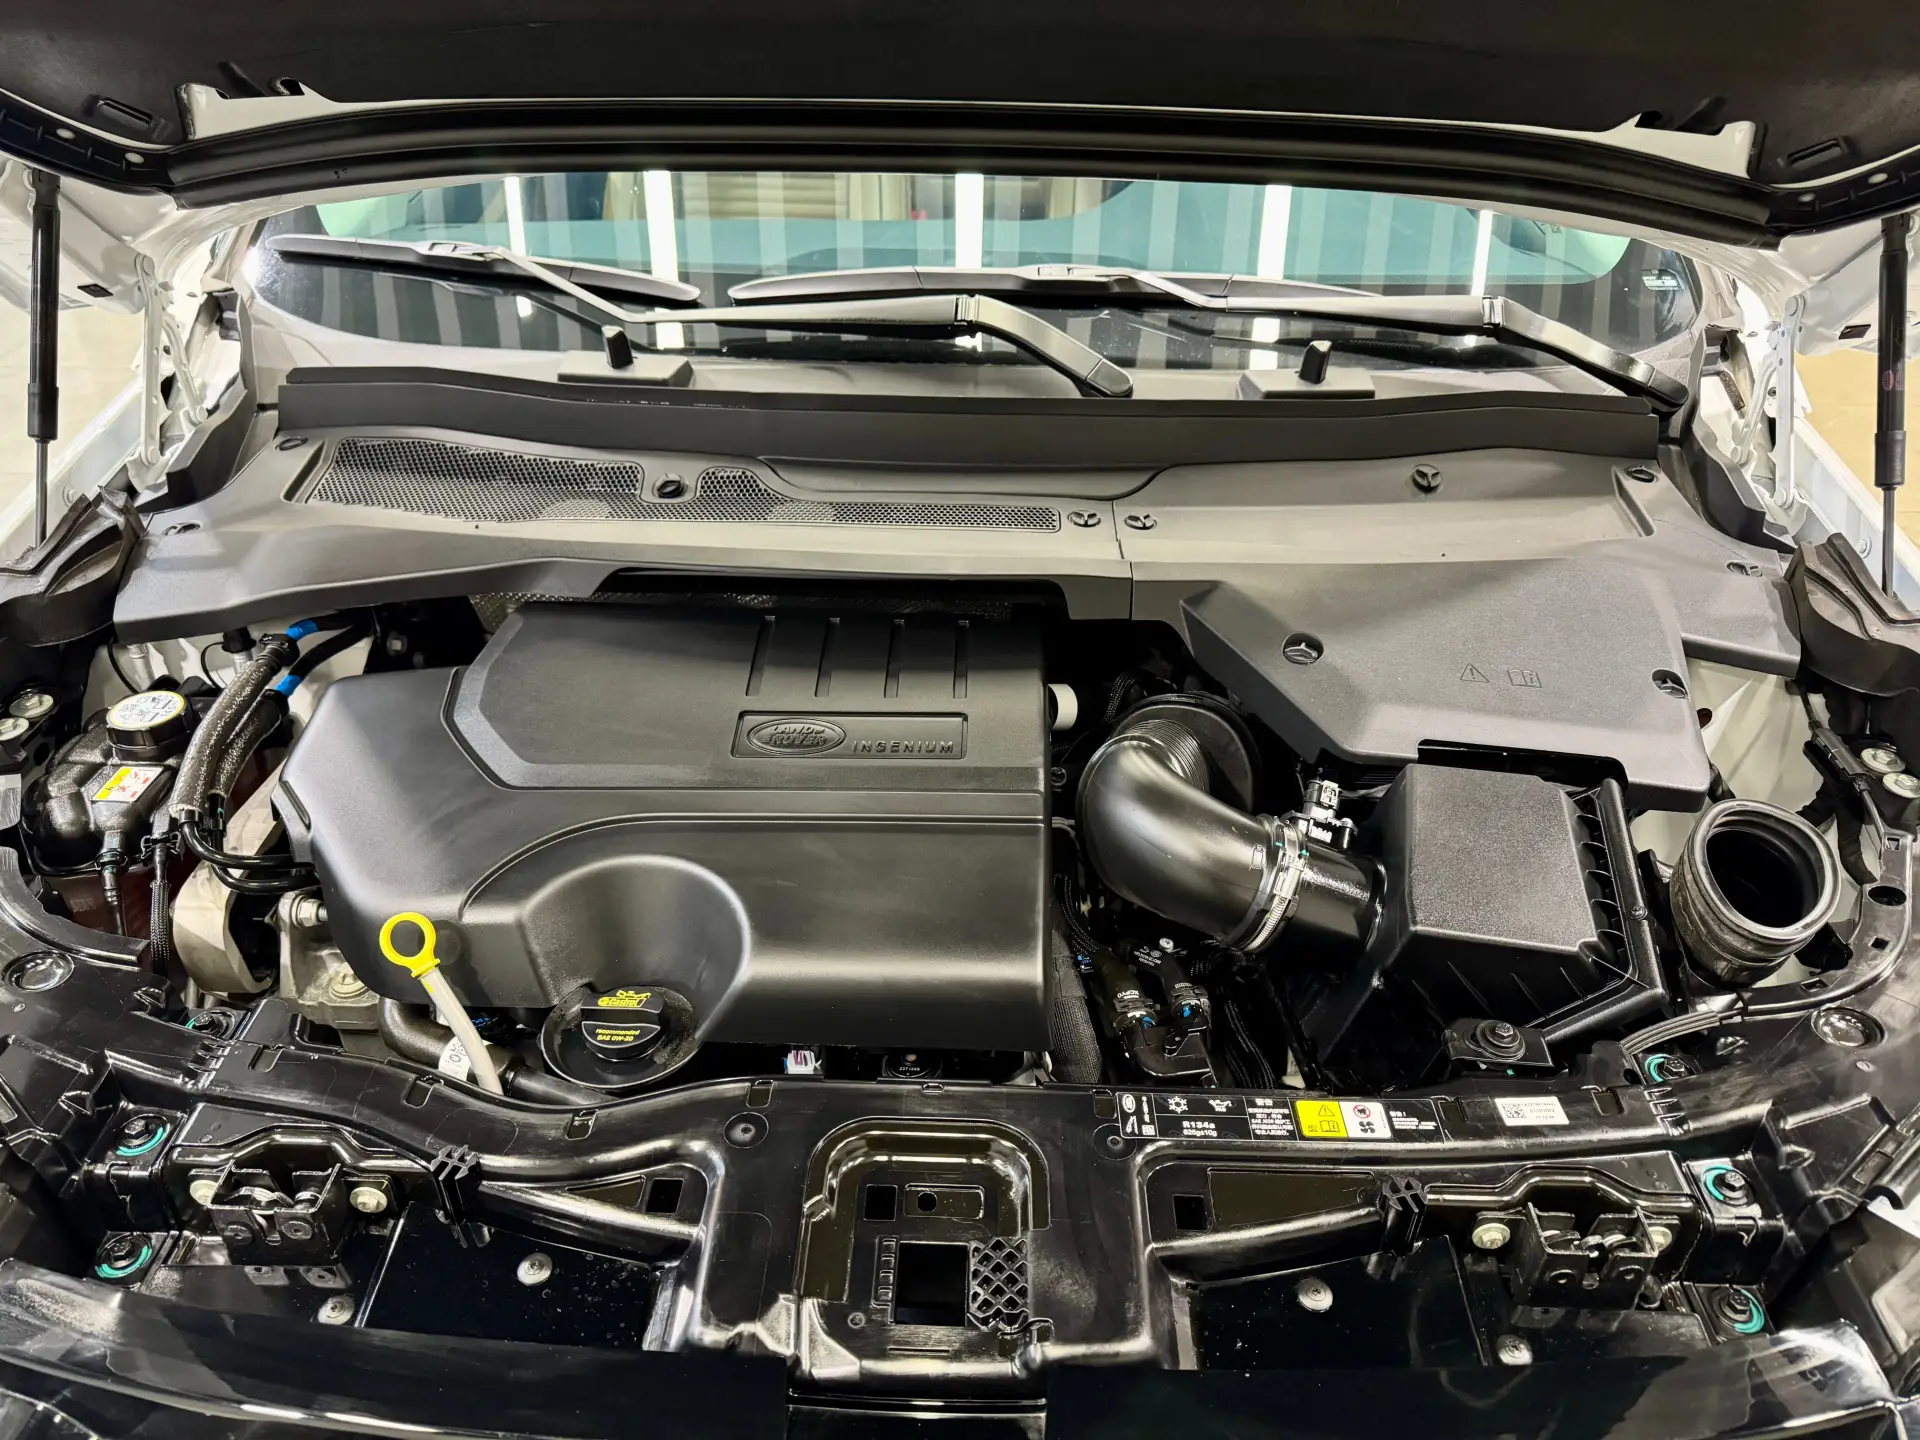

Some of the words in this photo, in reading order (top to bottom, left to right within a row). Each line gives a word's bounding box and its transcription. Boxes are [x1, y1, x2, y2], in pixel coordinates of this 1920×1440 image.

[770, 725, 821, 735] LAND
[769, 734, 827, 745] ROVER
[852, 740, 955, 754] INGENIUM
[609, 998, 639, 1006] Castrol
[1182, 1120, 1216, 1129] R134a
